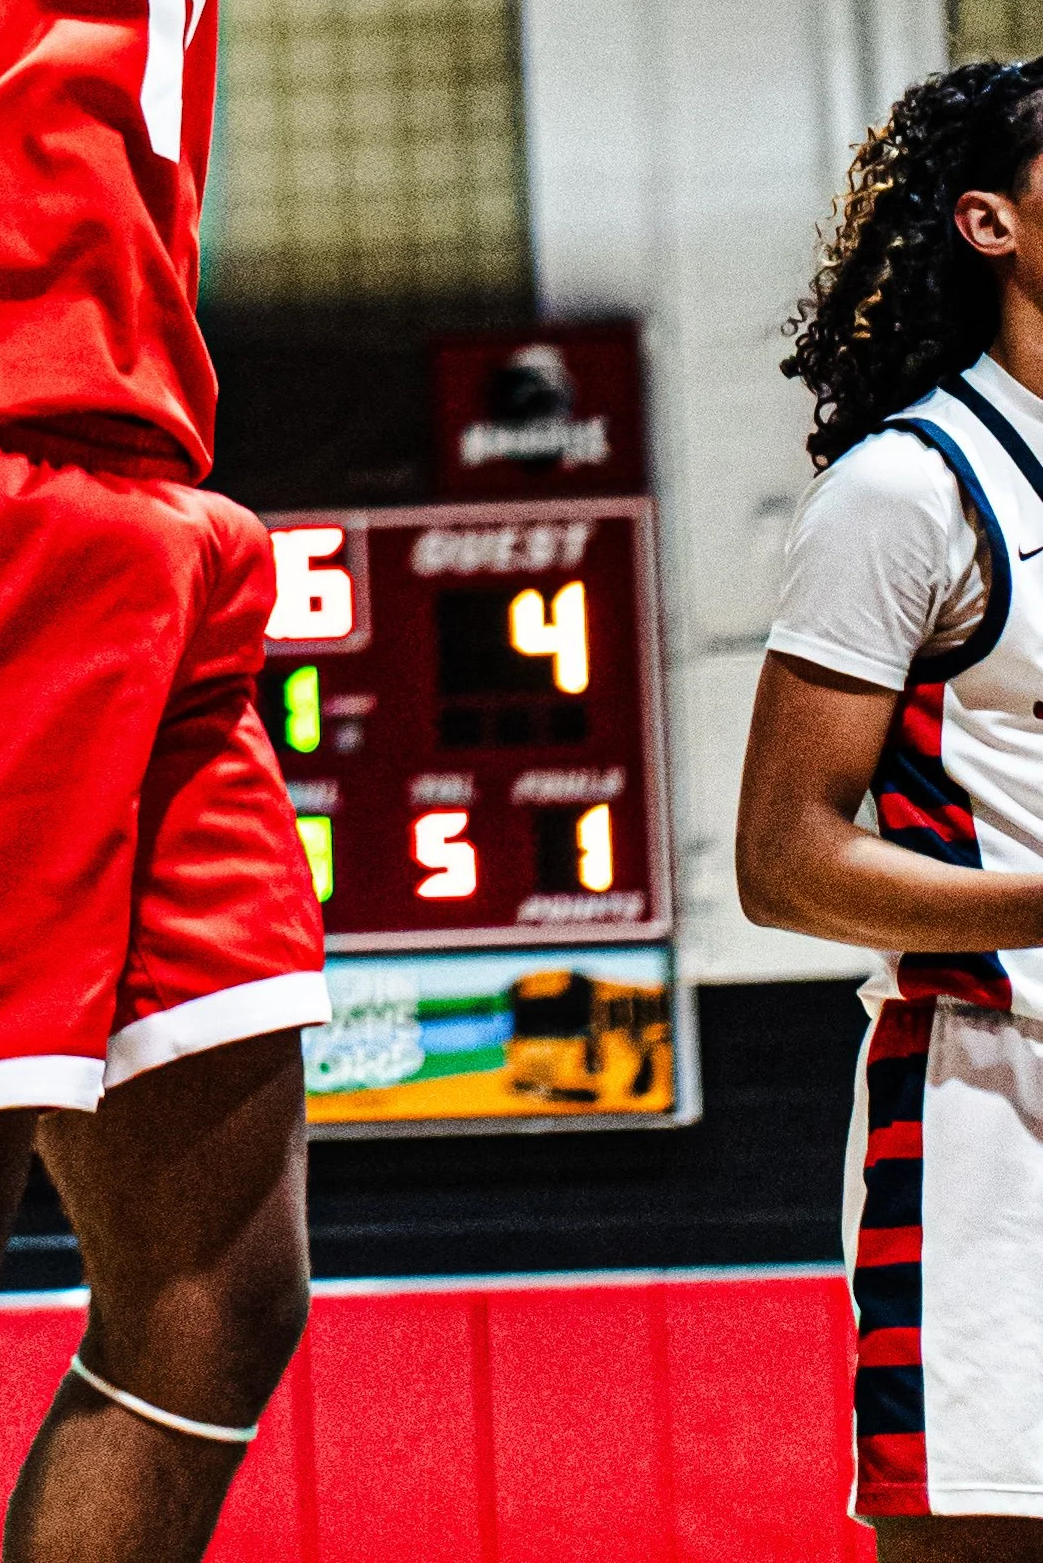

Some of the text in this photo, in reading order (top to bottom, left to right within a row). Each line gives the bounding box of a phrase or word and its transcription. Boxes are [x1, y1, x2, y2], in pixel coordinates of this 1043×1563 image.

[264, 525, 354, 639] 6
[412, 522, 592, 576] GUEST
[509, 581, 589, 694] 4
[284, 665, 321, 753] 1
[411, 807, 478, 899] 5
[576, 803, 614, 892] 1
